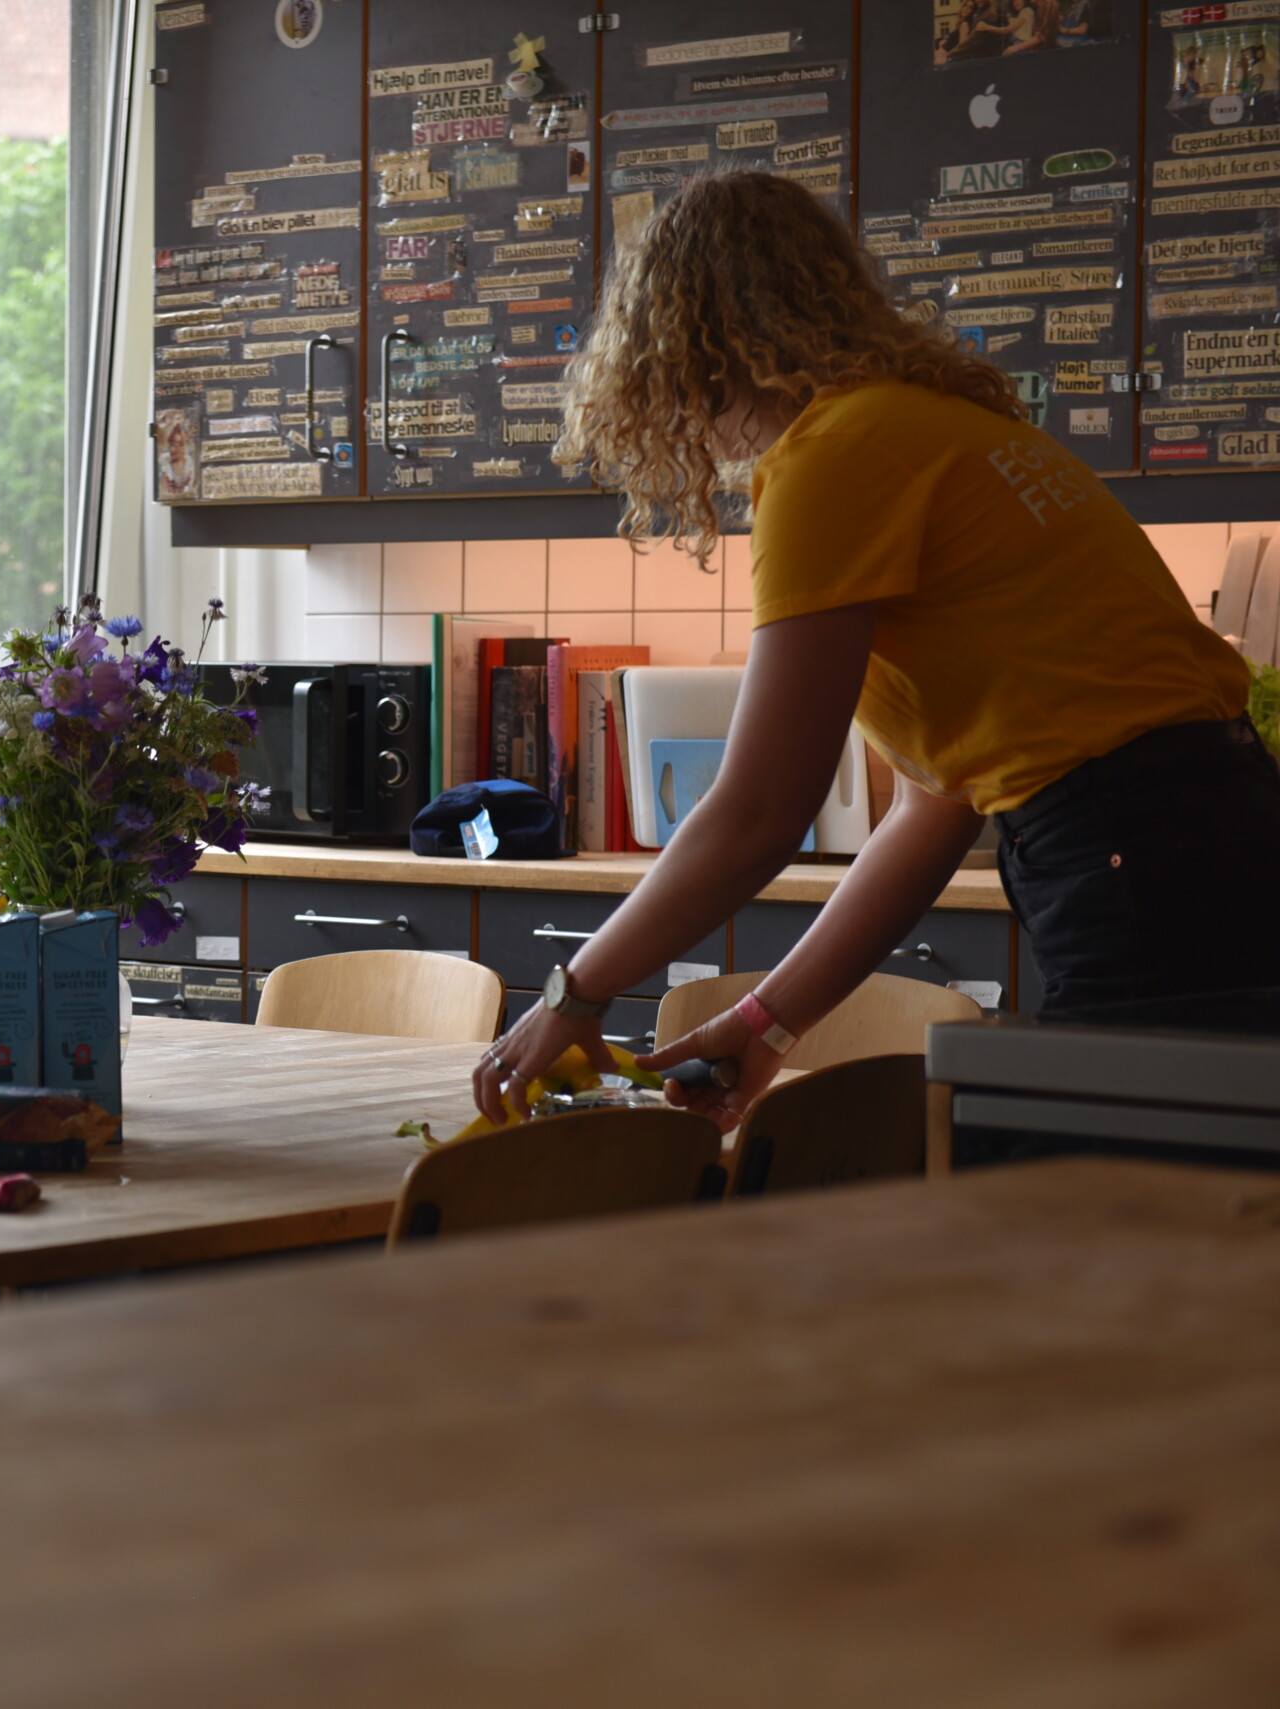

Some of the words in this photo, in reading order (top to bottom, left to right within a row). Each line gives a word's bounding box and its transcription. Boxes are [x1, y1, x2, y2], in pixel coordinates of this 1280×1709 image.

[374, 69, 415, 92] Hjælp
[419, 67, 440, 85] din
[444, 62, 489, 83] mave!
[693, 80, 720, 93] Hvem
[721, 76, 740, 88] skal
[741, 73, 776, 87] komme
[778, 70, 799, 83] efter
[421, 91, 455, 110] HAN
[461, 88, 481, 105] ER
[415, 118, 504, 145] STJERNE
[718, 126, 734, 147] hop
[743, 123, 775, 142] vandet
[1175, 129, 1257, 153] Legendarisk
[776, 138, 842, 164] frontfigur
[650, 169, 677, 187] læge
[941, 161, 1022, 195] LANG
[1155, 167, 1176, 181] Ret
[1180, 162, 1227, 181] højlydt
[1230, 160, 1249, 175] for
[1253, 160, 1269, 172] en
[1071, 183, 1128, 200] kemiker
[1152, 192, 1246, 214] meningsfuldt
[287, 213, 316, 233] pillet
[866, 215, 912, 230] Gentleman
[958, 219, 997, 234] minutter
[999, 218, 1011, 231] fra
[1012, 219, 1021, 230] at
[1023, 215, 1052, 231] sparke
[1053, 212, 1095, 228] Silkeborg
[388, 237, 427, 258] FAR
[496, 240, 578, 261] Finansminister
[1034, 240, 1112, 257] Romantikeren
[1152, 242, 1176, 260] Det
[1180, 240, 1216, 259] gode
[1218, 237, 1263, 254] hjerte
[1164, 296, 1203, 310] Kvinde
[947, 308, 984, 326] Stjerne
[1001, 306, 1034, 323] hjerne
[1049, 309, 1111, 327] Christian
[1056, 324, 1100, 342] Italien
[1186, 333, 1242, 352] Endnu
[1247, 333, 1267, 349] en
[416, 360, 456, 373] BEDSTE
[1057, 361, 1085, 377] Højt
[1186, 349, 1280, 374] supermark
[1056, 375, 1101, 391] humør
[1172, 385, 1208, 399] ekstra
[1211, 384, 1239, 401] godt
[372, 401, 428, 423] pssegod
[432, 399, 443, 416] til
[445, 402, 459, 416] at
[1144, 410, 1176, 424] finder
[1178, 406, 1245, 422] nullermænd
[408, 418, 474, 436] menneske
[1071, 423, 1108, 434] ROLEX
[1221, 433, 1270, 458] Glad
[5, 970, 27, 981] FREE
[85, 969, 108, 980] FREE
[54, 980, 107, 991] SWEETNESS
